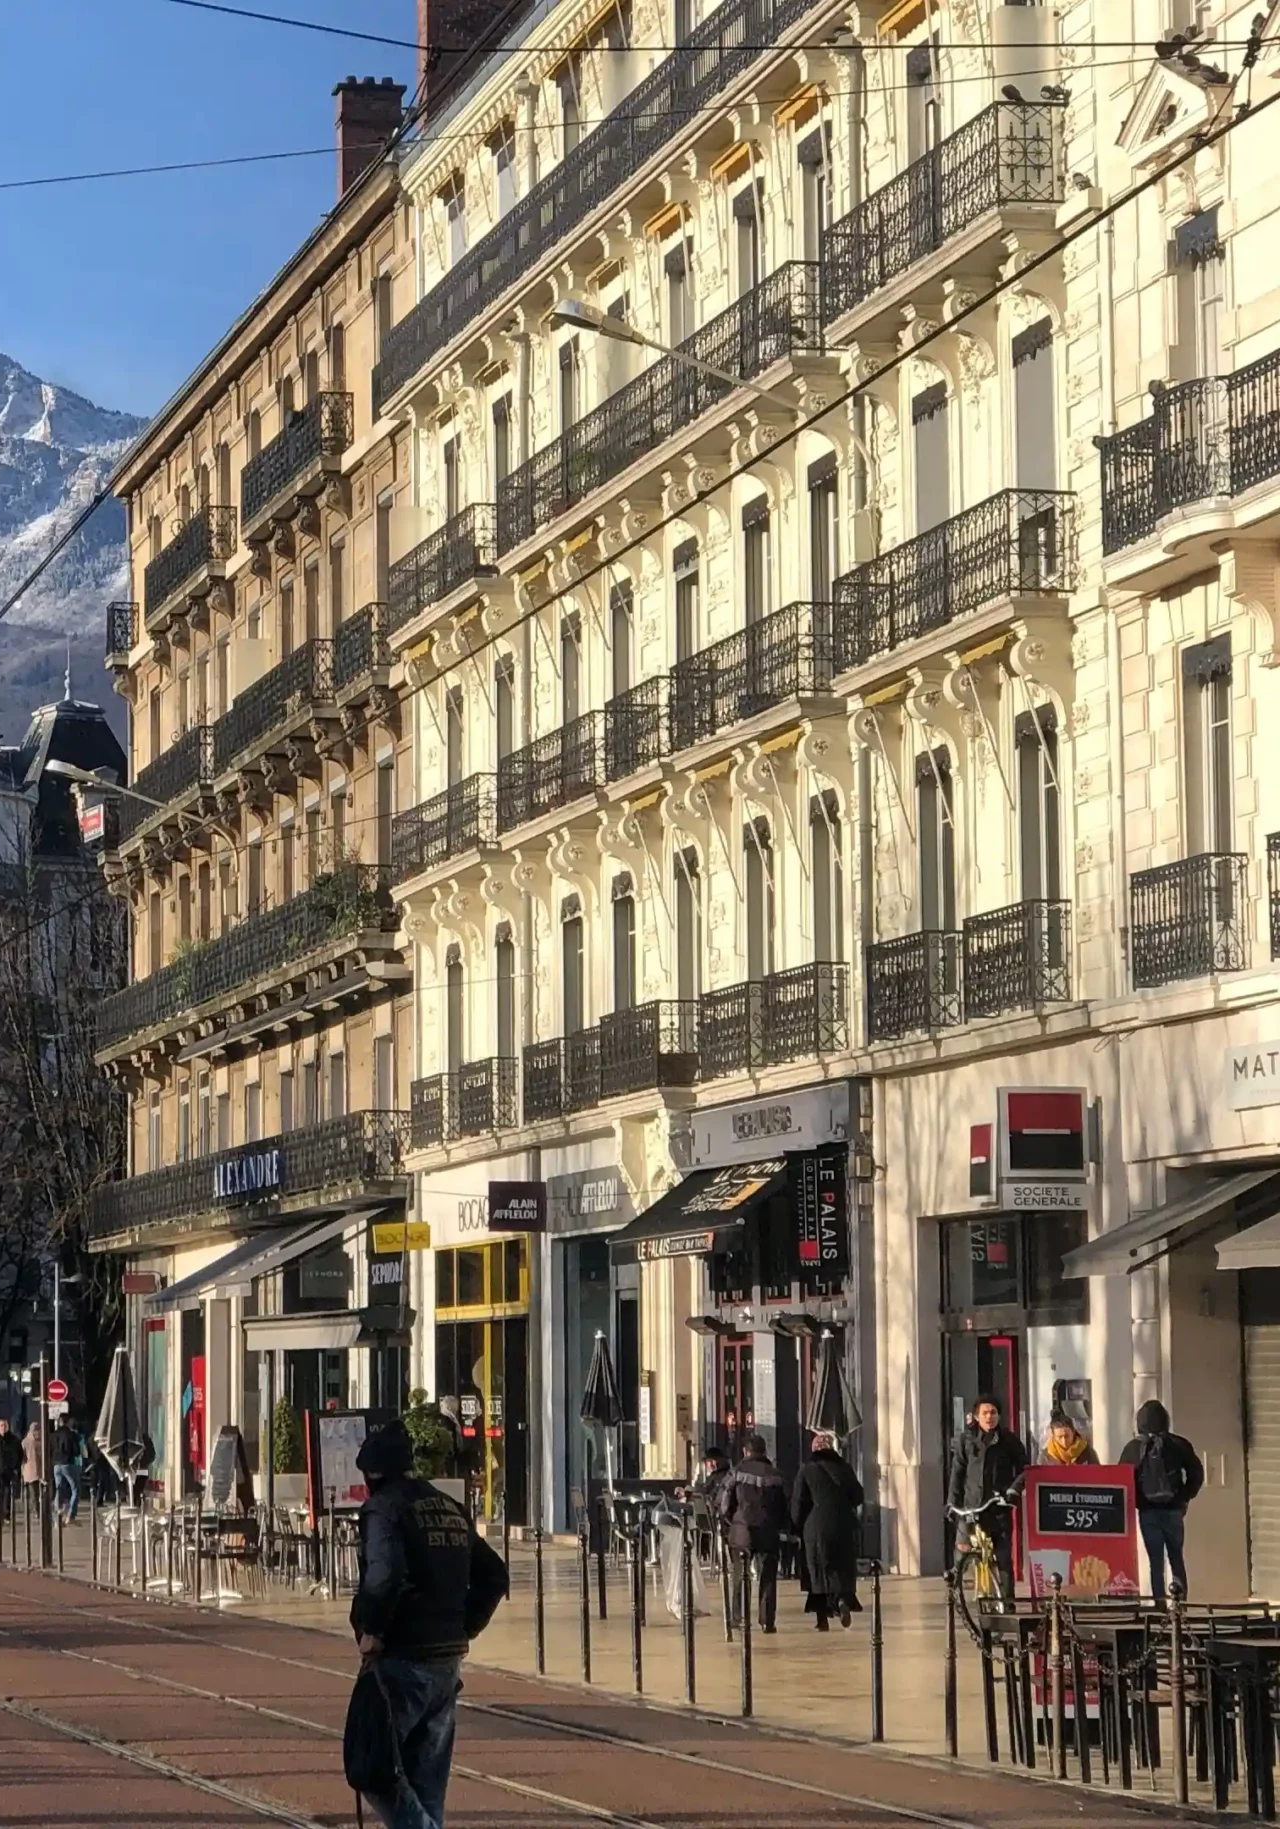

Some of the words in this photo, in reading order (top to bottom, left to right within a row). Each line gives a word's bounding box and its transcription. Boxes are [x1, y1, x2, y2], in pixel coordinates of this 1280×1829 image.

[213, 1150, 279, 1198] ALEXANDRE
[820, 1158, 835, 1181] LE
[508, 1199, 537, 1209] ALAIN
[580, 1178, 618, 1214] AFFLELOU
[458, 1196, 489, 1232] BOCAG
[492, 1209, 537, 1220] AFFLELOU
[820, 1192, 838, 1259] PALAIS
[637, 1241, 646, 1260] LE
[647, 1237, 671, 1258] PALAIS
[1049, 1493, 1073, 1503] MENU
[1065, 1509, 1098, 1528] 5,95€
